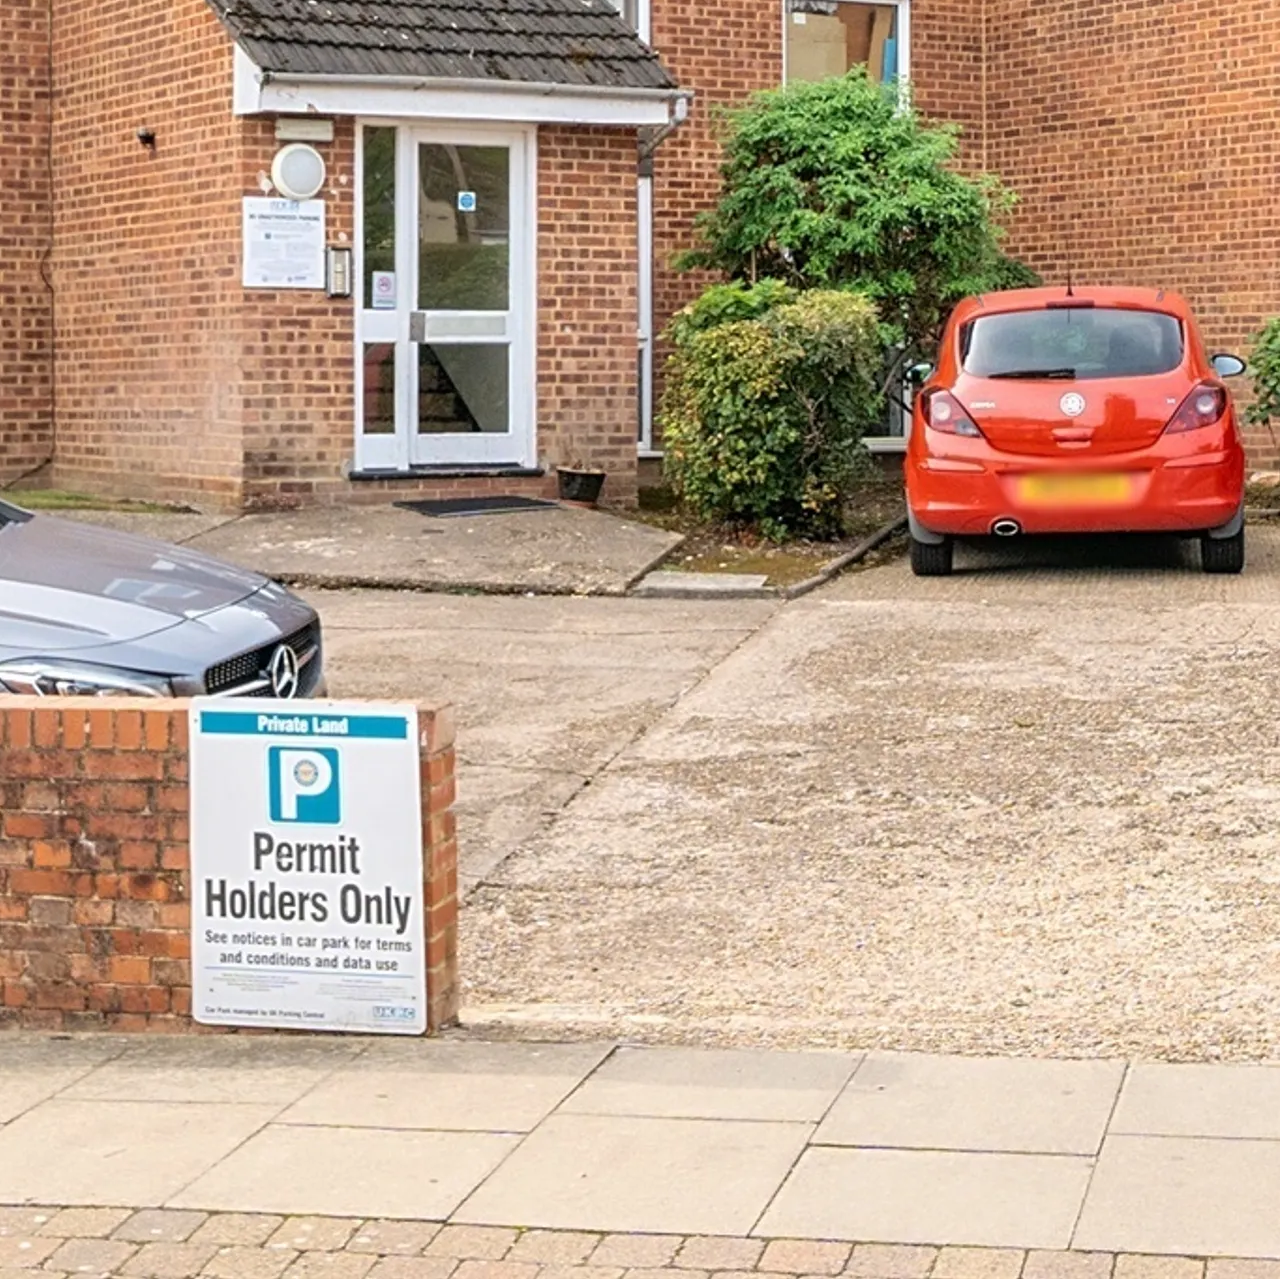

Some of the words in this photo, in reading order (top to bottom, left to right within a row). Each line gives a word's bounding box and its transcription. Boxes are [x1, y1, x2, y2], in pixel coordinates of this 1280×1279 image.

[257, 715, 309, 733] Private
[312, 717, 349, 734] Land
[253, 832, 360, 874] Permit
[205, 879, 328, 922] Holders
[340, 884, 412, 935] Only
[205, 929, 228, 944] See
[232, 931, 277, 946] notices
[281, 932, 293, 946] in
[297, 935, 317, 948] car
[322, 935, 349, 951] park
[355, 936, 372, 950] for
[376, 938, 412, 953] terms
[219, 951, 242, 964] and
[246, 952, 311, 967] conditions
[315, 955, 338, 969] and
[343, 956, 371, 970] data
[376, 959, 399, 971] use
